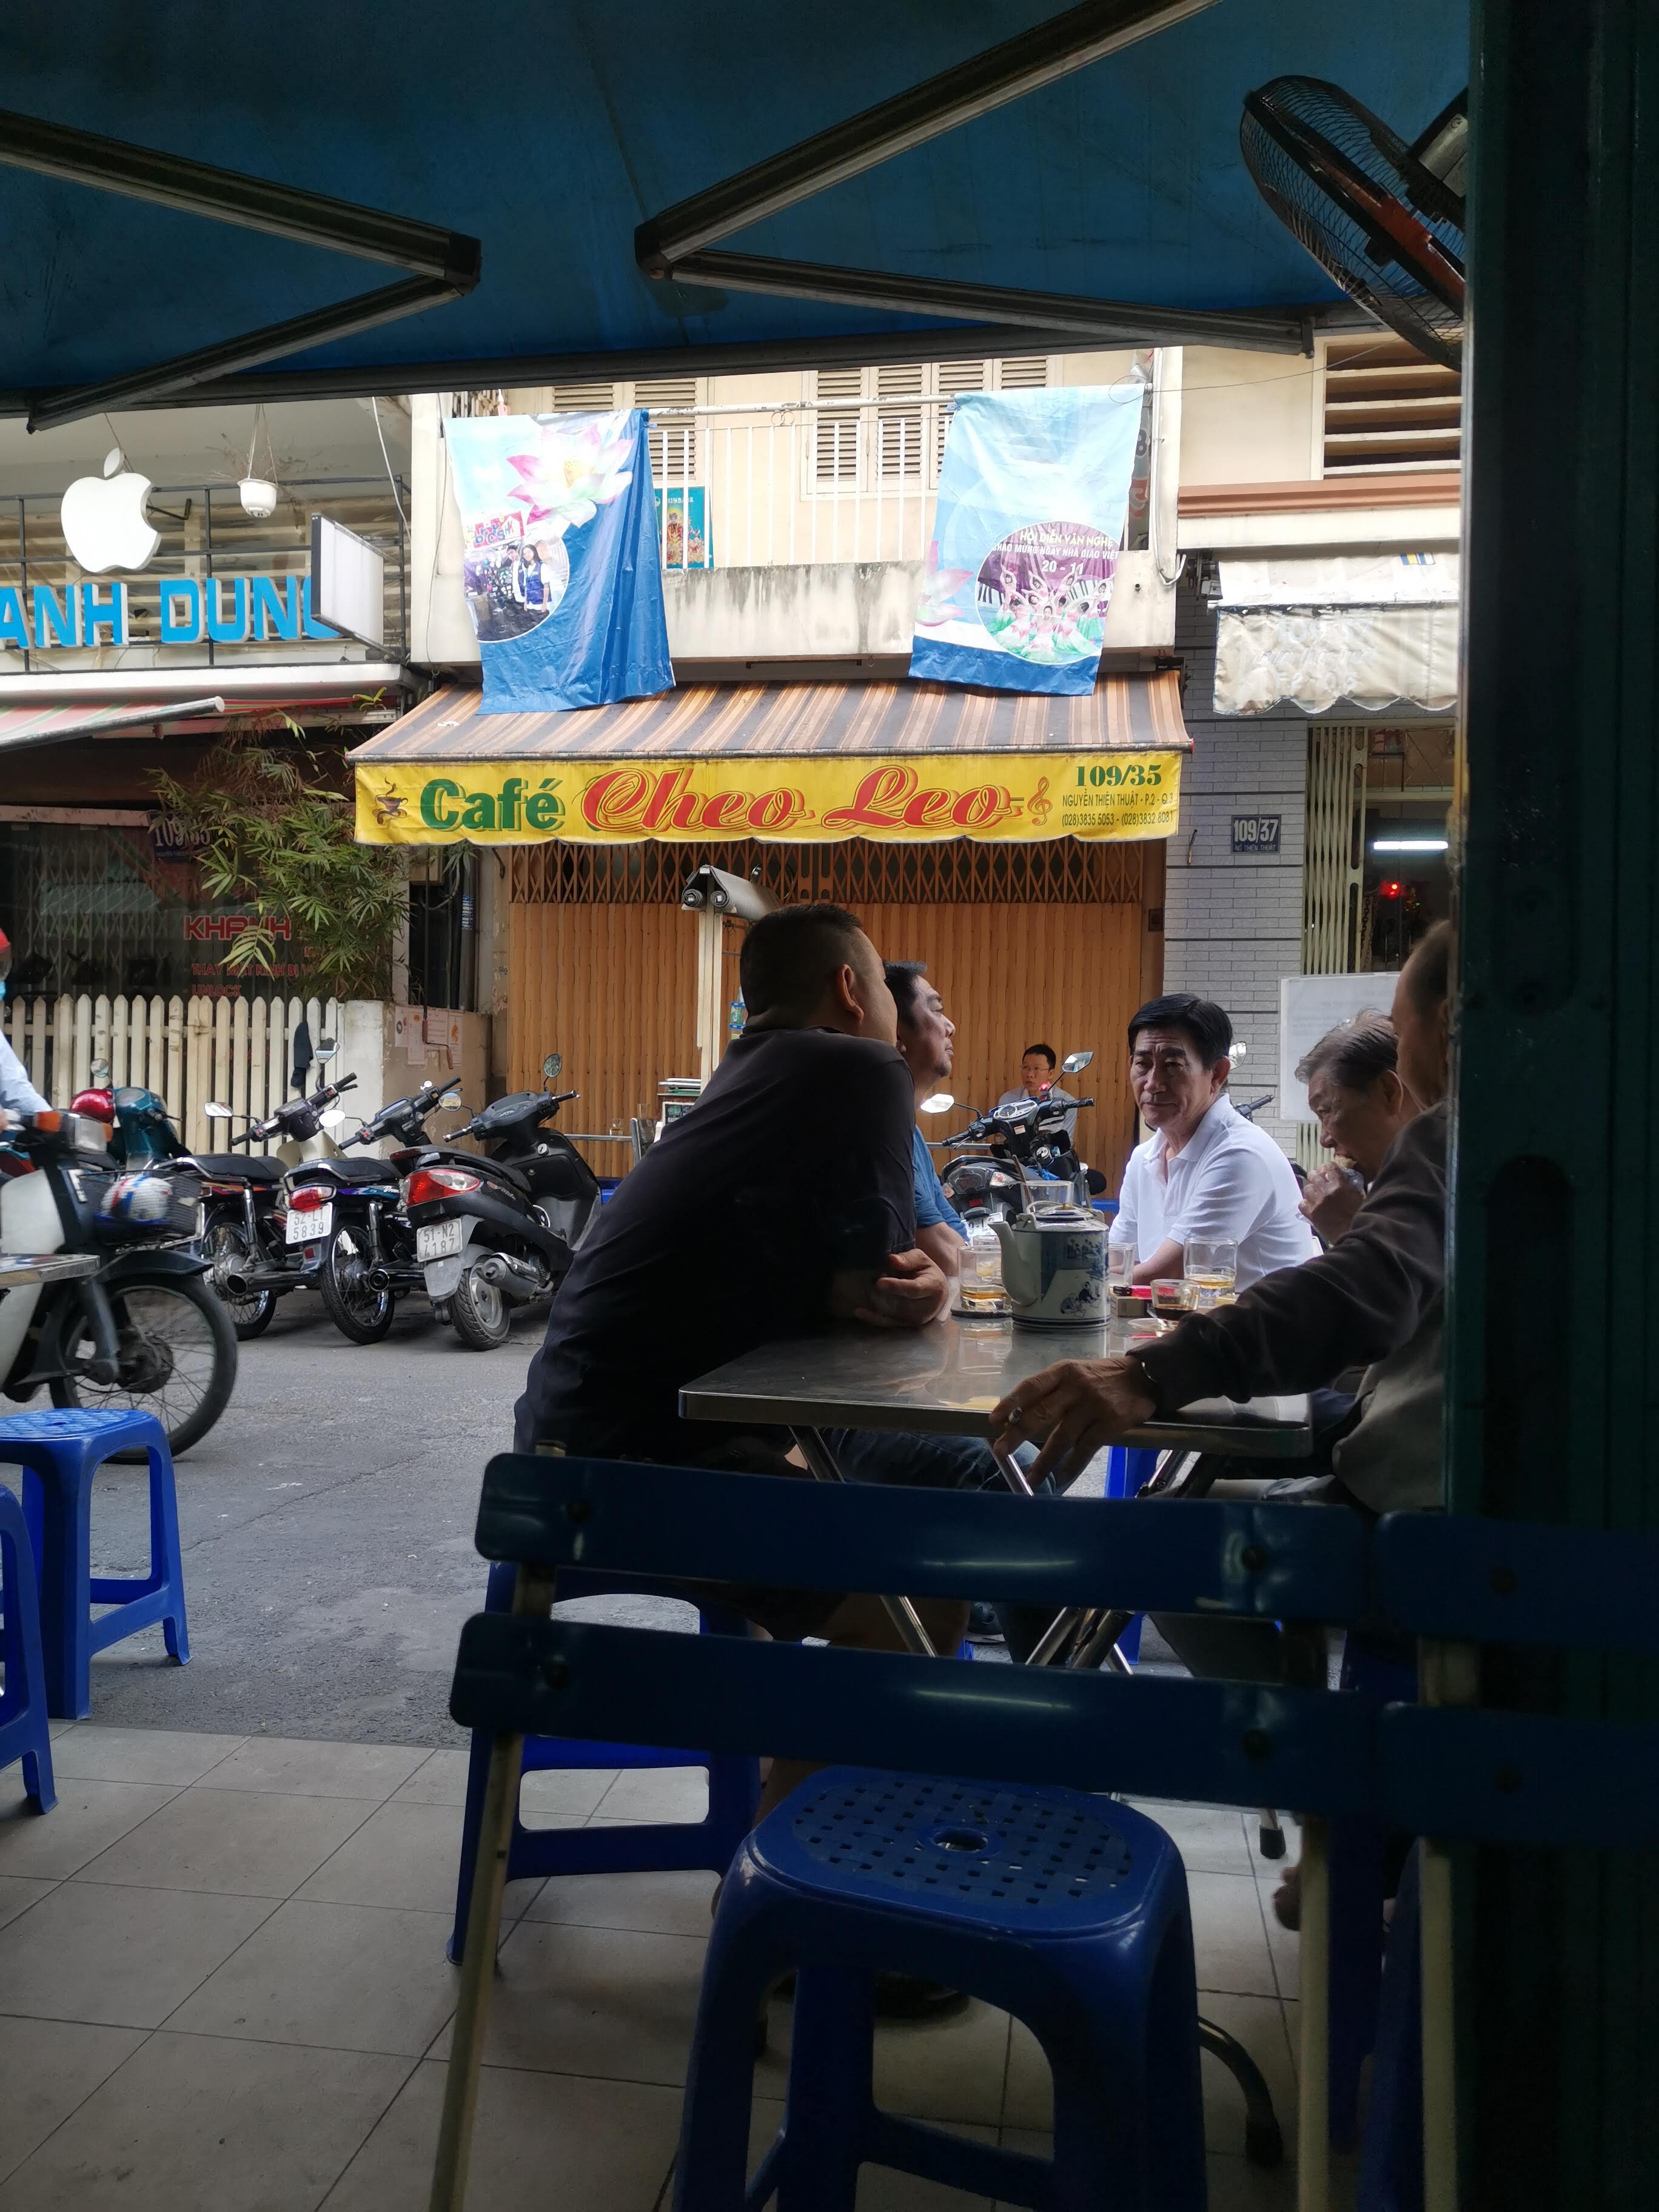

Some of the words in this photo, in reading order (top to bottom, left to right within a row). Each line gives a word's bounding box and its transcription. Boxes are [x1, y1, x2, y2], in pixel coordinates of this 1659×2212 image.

[1042, 560, 1057, 573] 20
[1070, 562, 1084, 575] 11
[1075, 764, 1162, 787] 109/35
[420, 777, 564, 831] Café
[580, 767, 815, 833] Cheo
[821, 764, 1024, 830] Leo
[1095, 791, 1115, 809] THIỆN
[1117, 791, 1138, 809] THUẬT
[1145, 793, 1155, 806] P.2
[1161, 793, 1173, 805] Q.3
[1062, 813, 1096, 827] (028)3835
[1098, 813, 1114, 825] 5053
[1122, 812, 1156, 826] (028)3832
[1158, 811, 1173, 823] 8081
[1234, 817, 1279, 843] 109/37
[190, 963, 222, 976] THAY
[191, 984, 242, 997] UNLOCK
[293, 1221, 324, 1240] 5839
[423, 1223, 455, 1242] 51-N2
[424, 1238, 455, 1257] 4187
